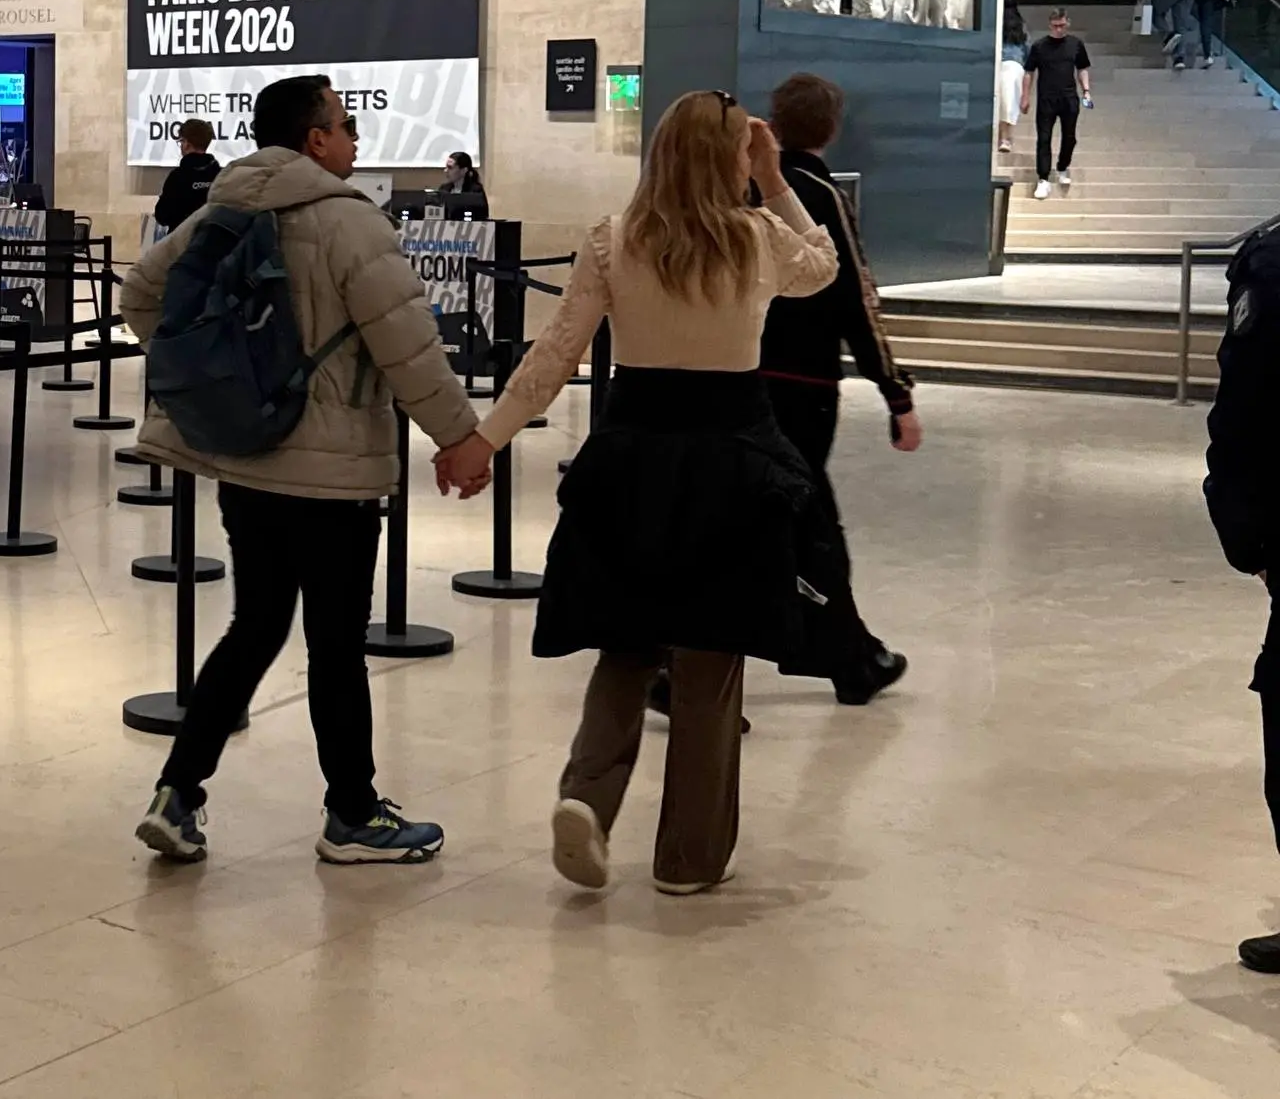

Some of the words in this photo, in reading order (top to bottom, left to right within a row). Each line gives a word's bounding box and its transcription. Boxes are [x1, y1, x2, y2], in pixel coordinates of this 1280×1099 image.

[146, 10, 219, 56] WEEK
[224, 6, 294, 53] 2026
[150, 93, 220, 113] WHERE
